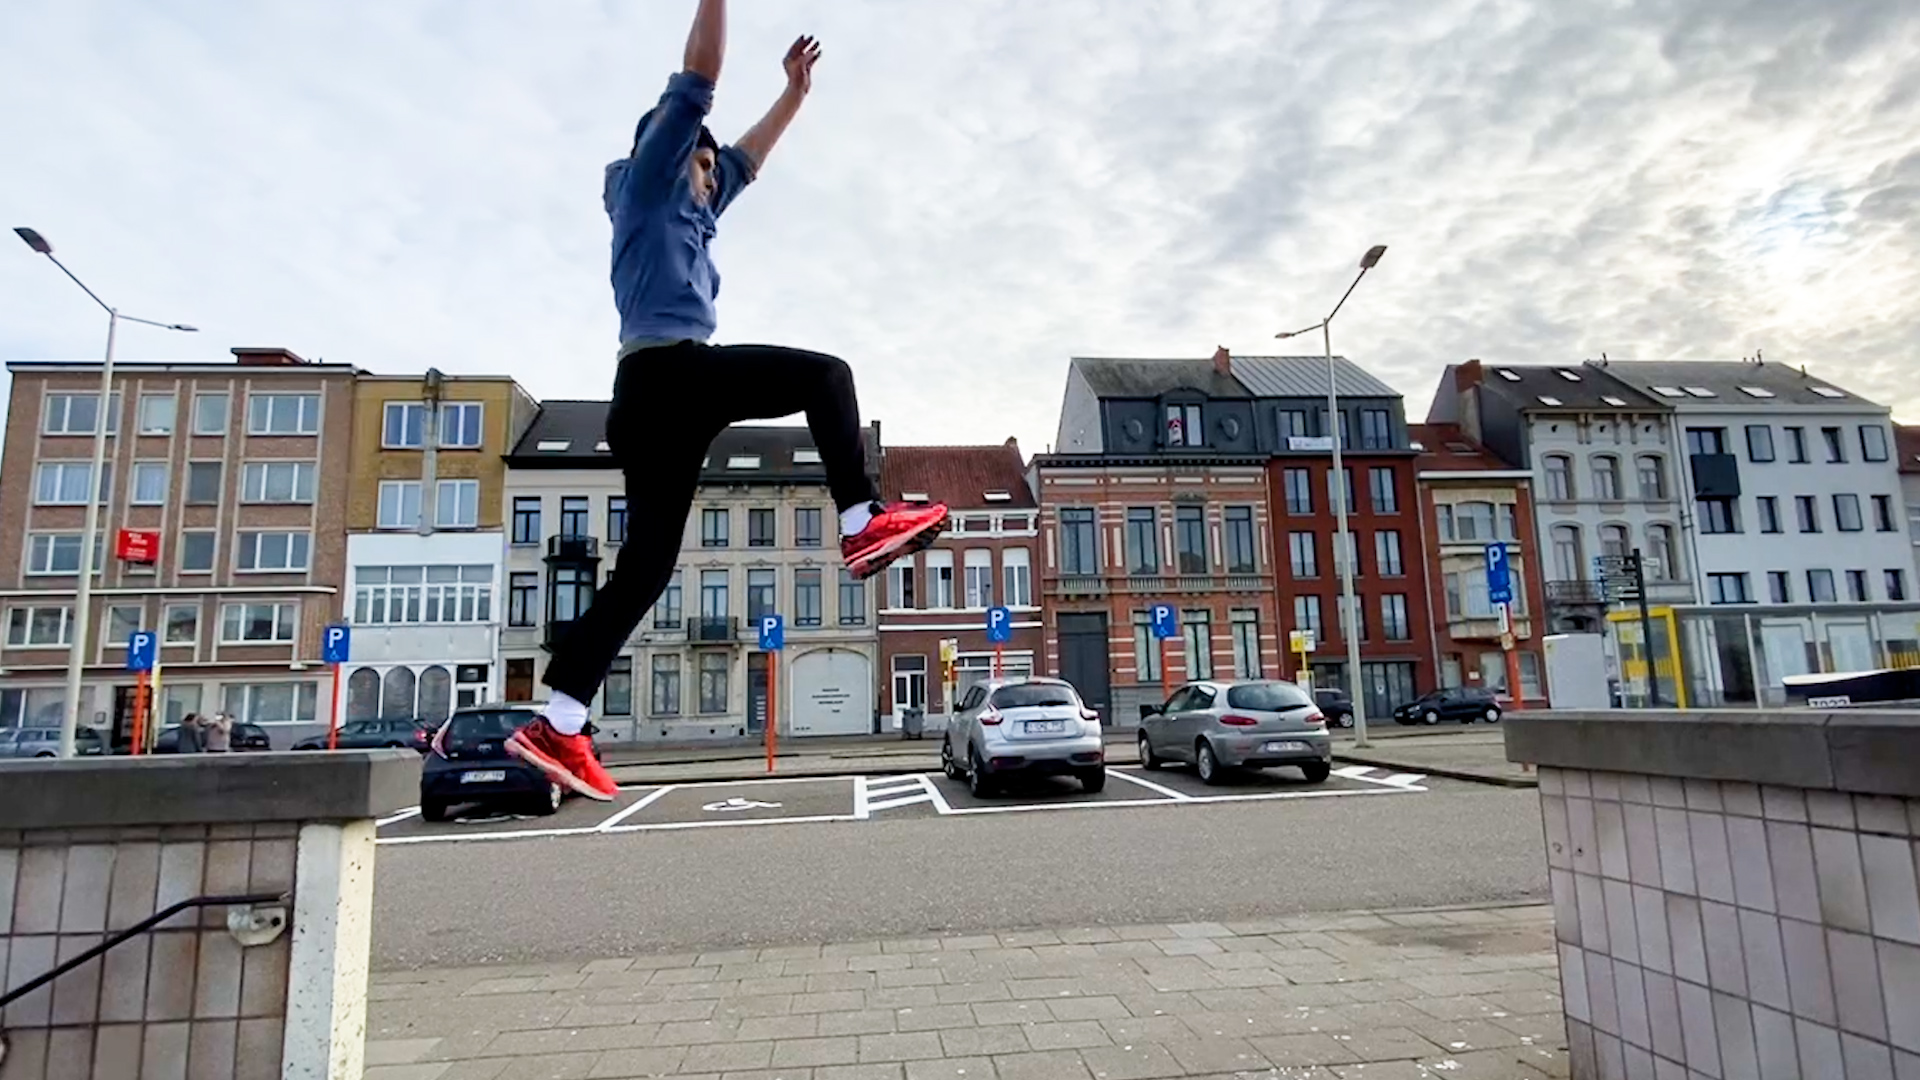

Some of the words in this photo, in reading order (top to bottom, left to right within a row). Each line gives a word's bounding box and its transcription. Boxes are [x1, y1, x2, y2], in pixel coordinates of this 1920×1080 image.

[1488, 546, 1501, 571] P
[991, 610, 1004, 628] P
[1156, 606, 1169, 624] P
[764, 617, 777, 636] P
[134, 634, 149, 655] P
[329, 628, 344, 648] P
